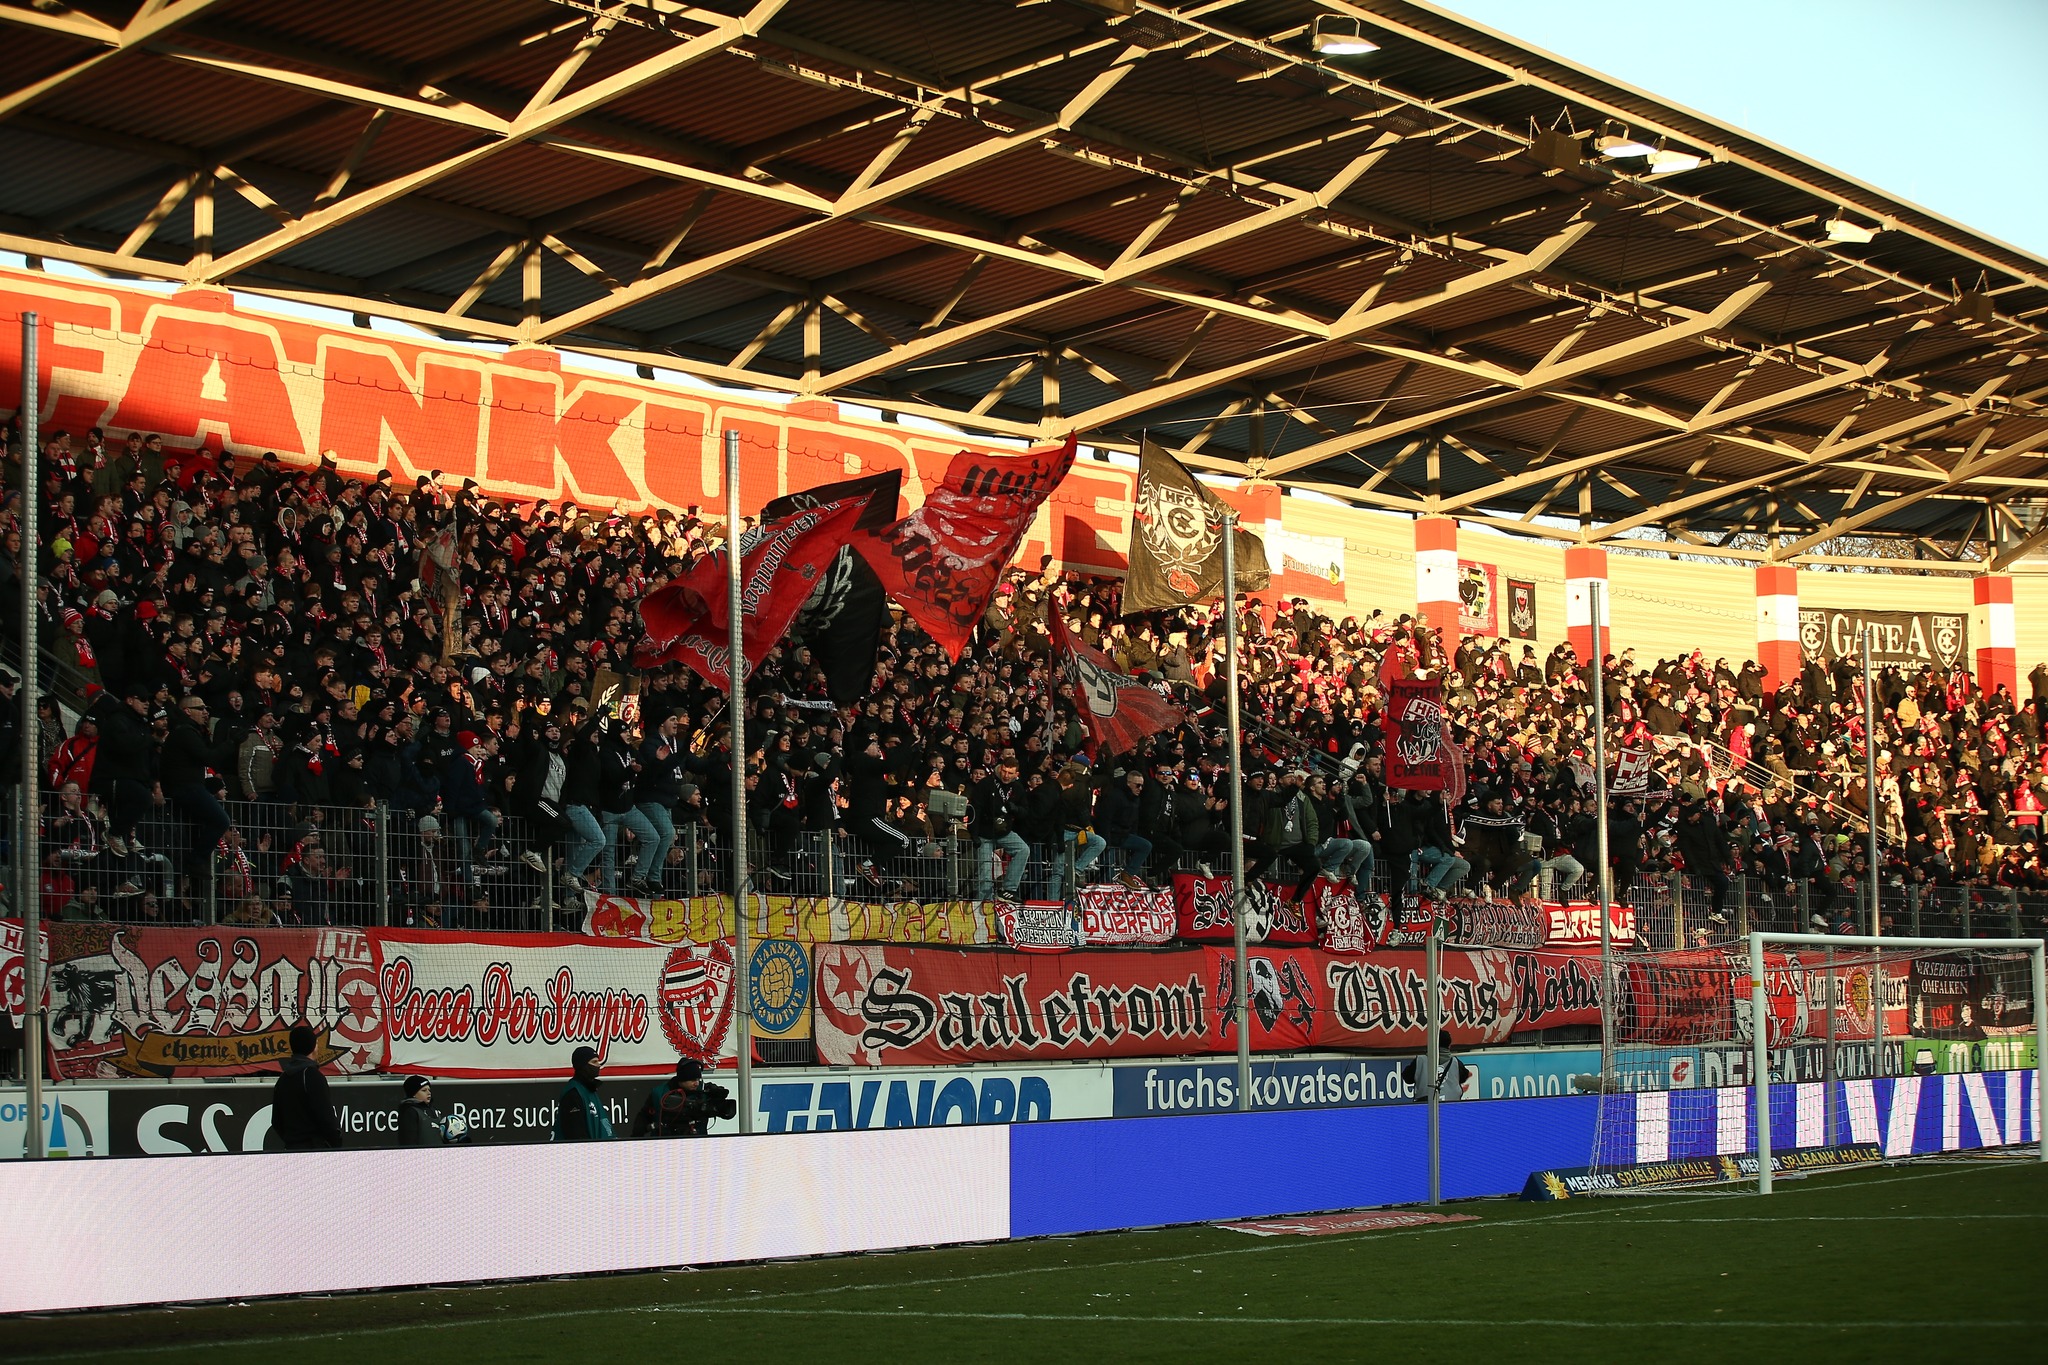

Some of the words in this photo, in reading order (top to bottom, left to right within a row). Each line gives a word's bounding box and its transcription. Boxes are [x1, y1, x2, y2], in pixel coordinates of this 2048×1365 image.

[0, 280, 1134, 570] FANKURE
[1164, 490, 1195, 507] HFC
[1831, 613, 1903, 658] GATE
[1908, 616, 1932, 659] A
[1017, 910, 1062, 928] SEKTION
[1083, 911, 1177, 935] QUERFUR
[1013, 928, 1076, 945] WEISSENFELS
[755, 941, 806, 979] FANSZENE
[1327, 958, 1498, 1034] Ultras
[1513, 953, 1603, 1025] Köthe
[476, 961, 540, 1047] Per
[540, 964, 650, 1068] Sempre
[863, 966, 1208, 1052] Saalefront
[162, 1040, 229, 1062] chemie
[1839, 1147, 1882, 1163] HALLE
[1616, 1164, 1680, 1187] SPIELBANK
[1680, 1160, 1715, 1179] HALLE
